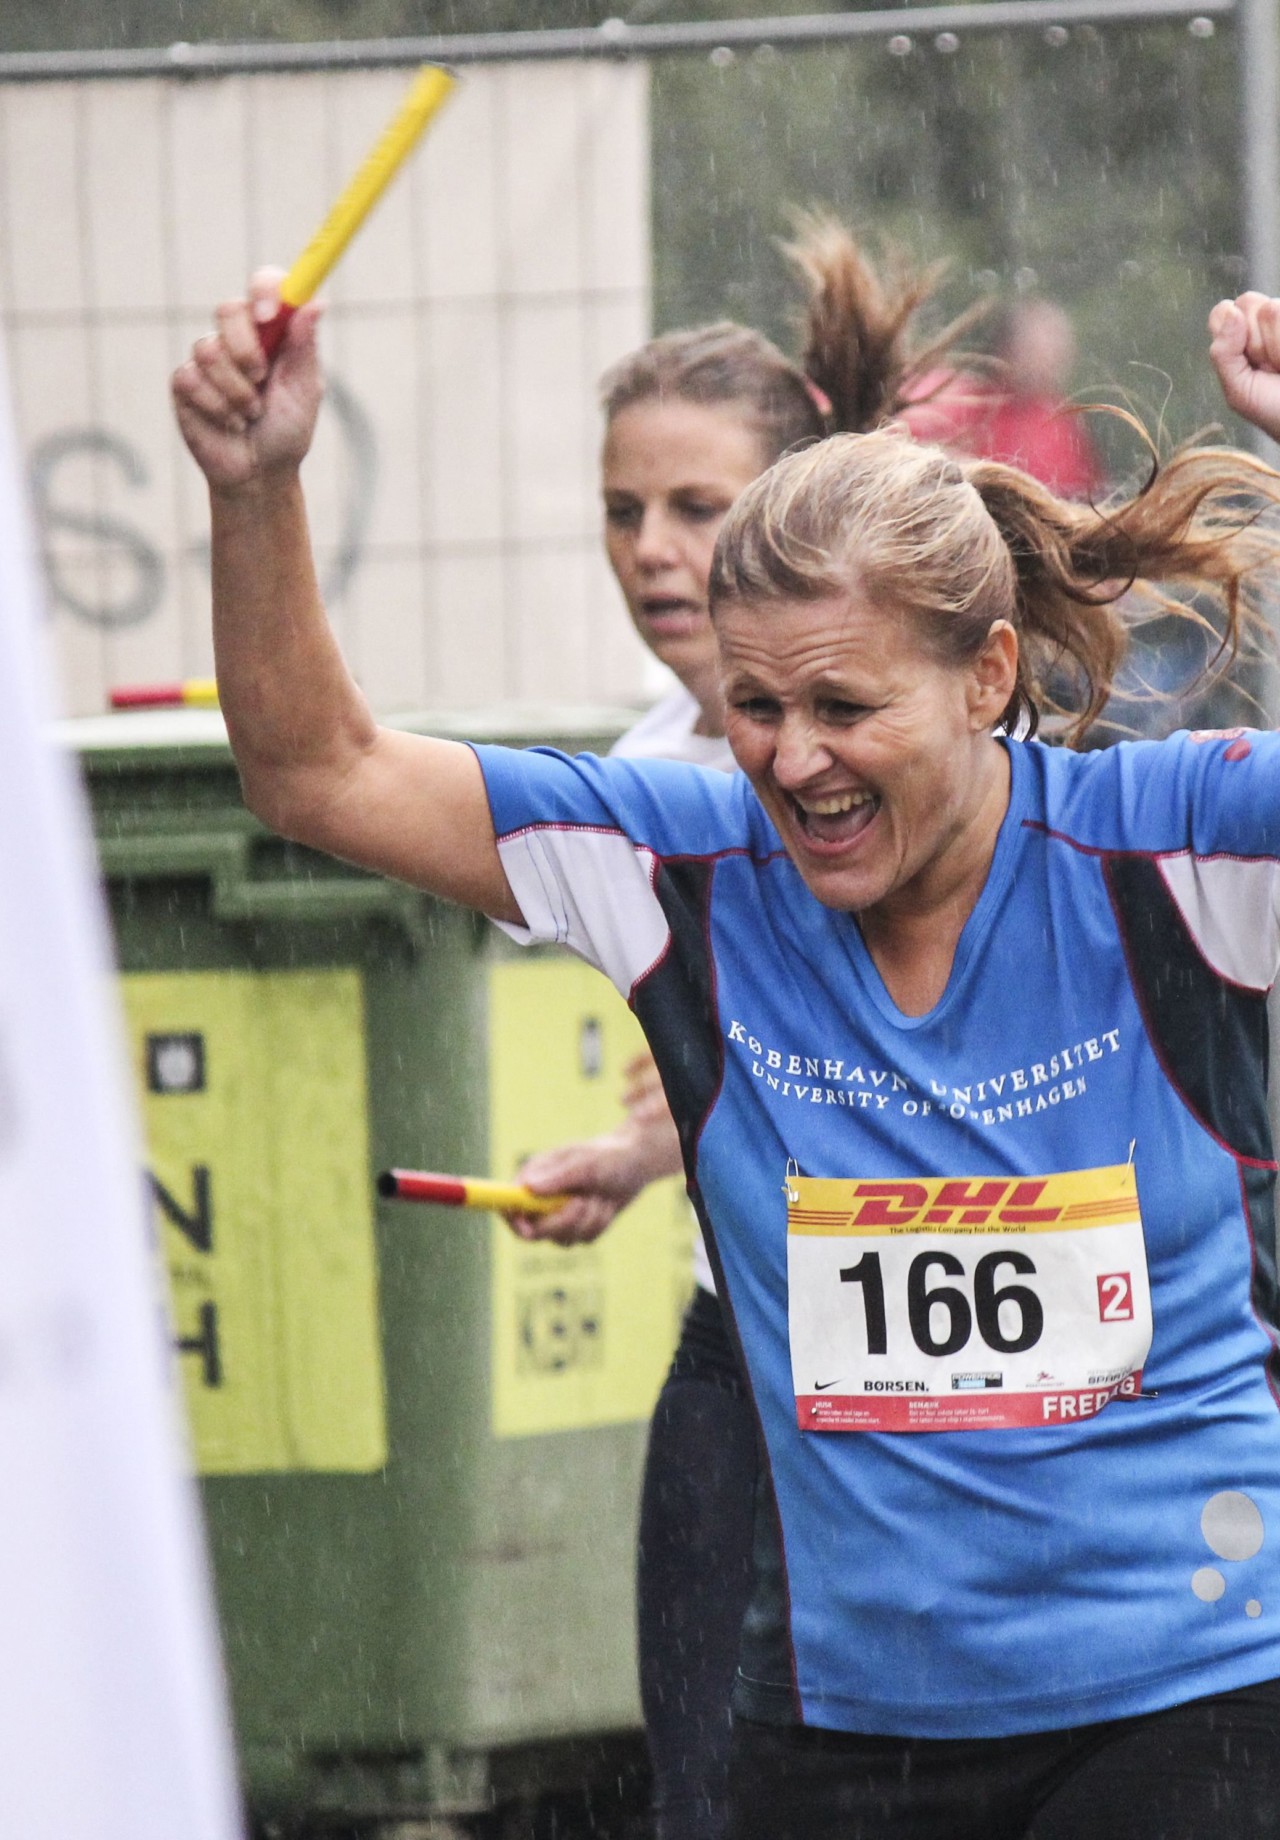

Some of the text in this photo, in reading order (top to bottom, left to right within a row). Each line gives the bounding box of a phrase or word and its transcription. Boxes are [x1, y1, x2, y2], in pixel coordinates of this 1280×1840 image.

[752, 1060, 890, 1109] UNIVERSITY
[902, 1099, 931, 1117] OF
[930, 1028, 1121, 1104] UNIVERSITET
[851, 1181, 1063, 1226] DHL
[839, 1250, 1044, 1357] 166
[1100, 1276, 1130, 1321] 2
[863, 1380, 929, 1393] BØRSEN.
[1042, 1376, 1136, 1420] FREDAG
